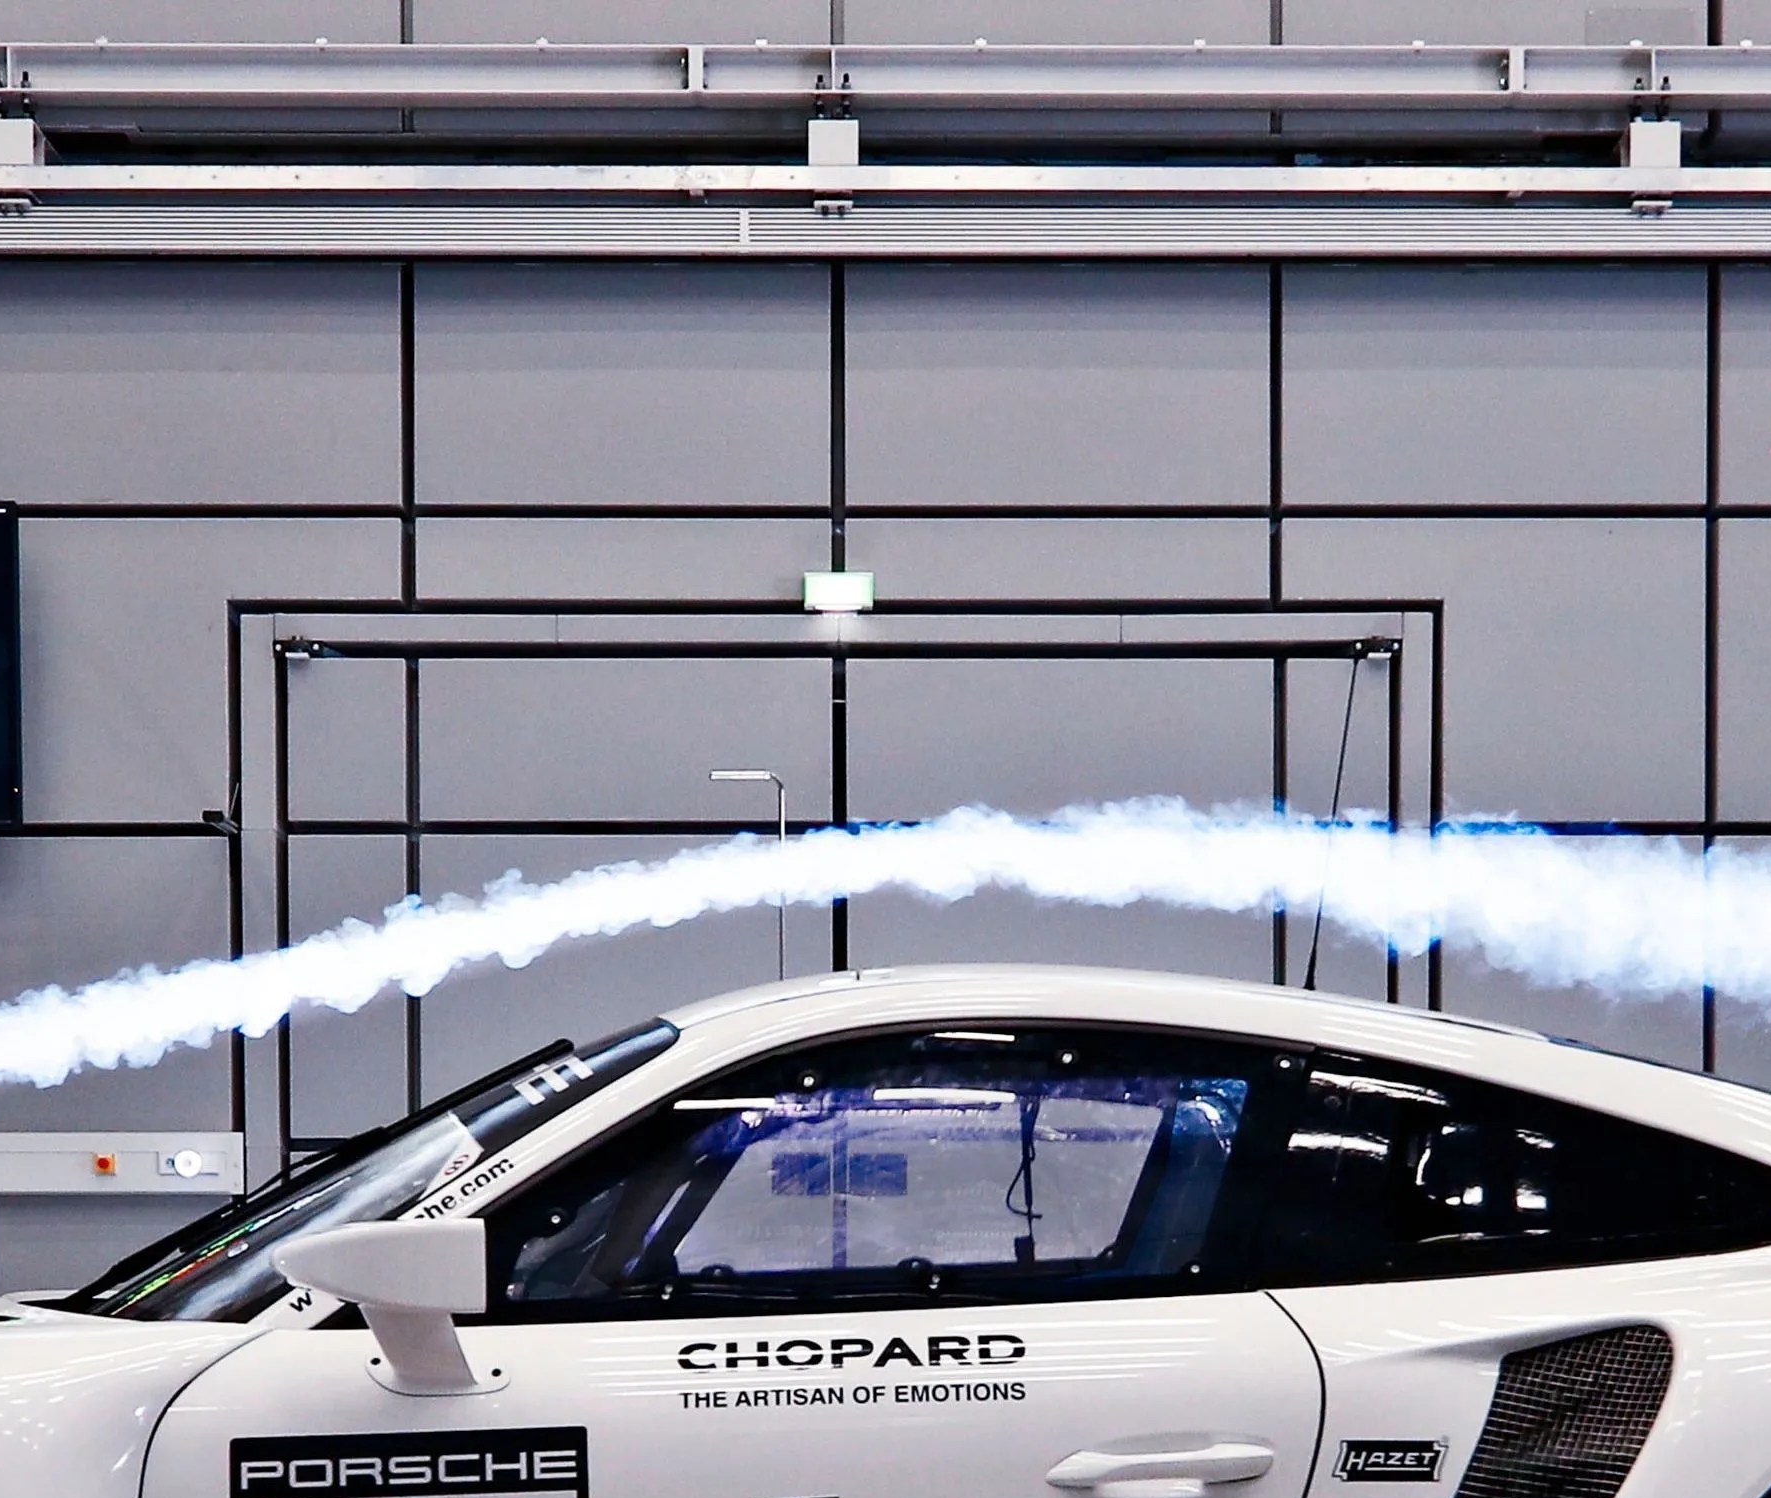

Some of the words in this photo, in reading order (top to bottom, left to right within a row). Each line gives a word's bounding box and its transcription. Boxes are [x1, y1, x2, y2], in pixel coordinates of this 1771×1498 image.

[677, 1334, 1026, 1371] CHOPARD
[680, 1391, 727, 1409] THE
[735, 1387, 844, 1408] ARTISAN
[853, 1385, 886, 1404] OF
[897, 1382, 1026, 1403] EMOTIONS
[240, 1450, 578, 1490] PORSCHE
[1345, 1451, 1435, 1471] HAZET
